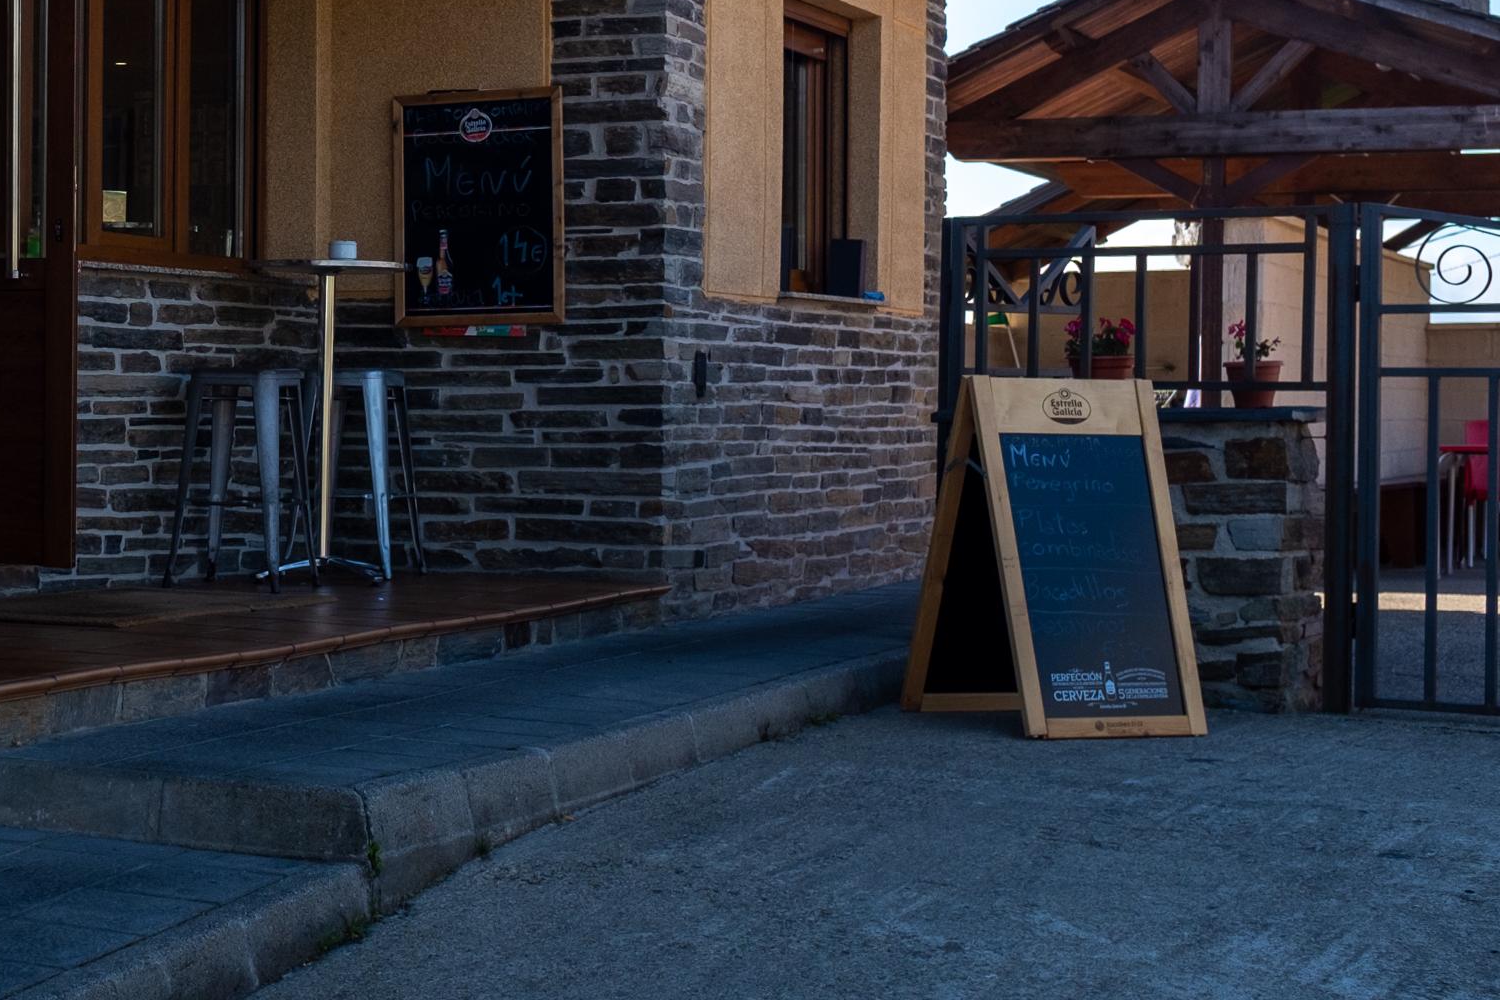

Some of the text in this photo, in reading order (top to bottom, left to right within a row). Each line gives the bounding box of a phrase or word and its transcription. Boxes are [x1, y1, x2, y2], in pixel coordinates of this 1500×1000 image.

[1050, 398, 1082, 408] Estrella
[1052, 407, 1082, 416] Galicia
[1051, 671, 1102, 682] PERFECCIÓN
[1053, 689, 1105, 702] CERVEZA
[1118, 688, 1126, 700] 5
